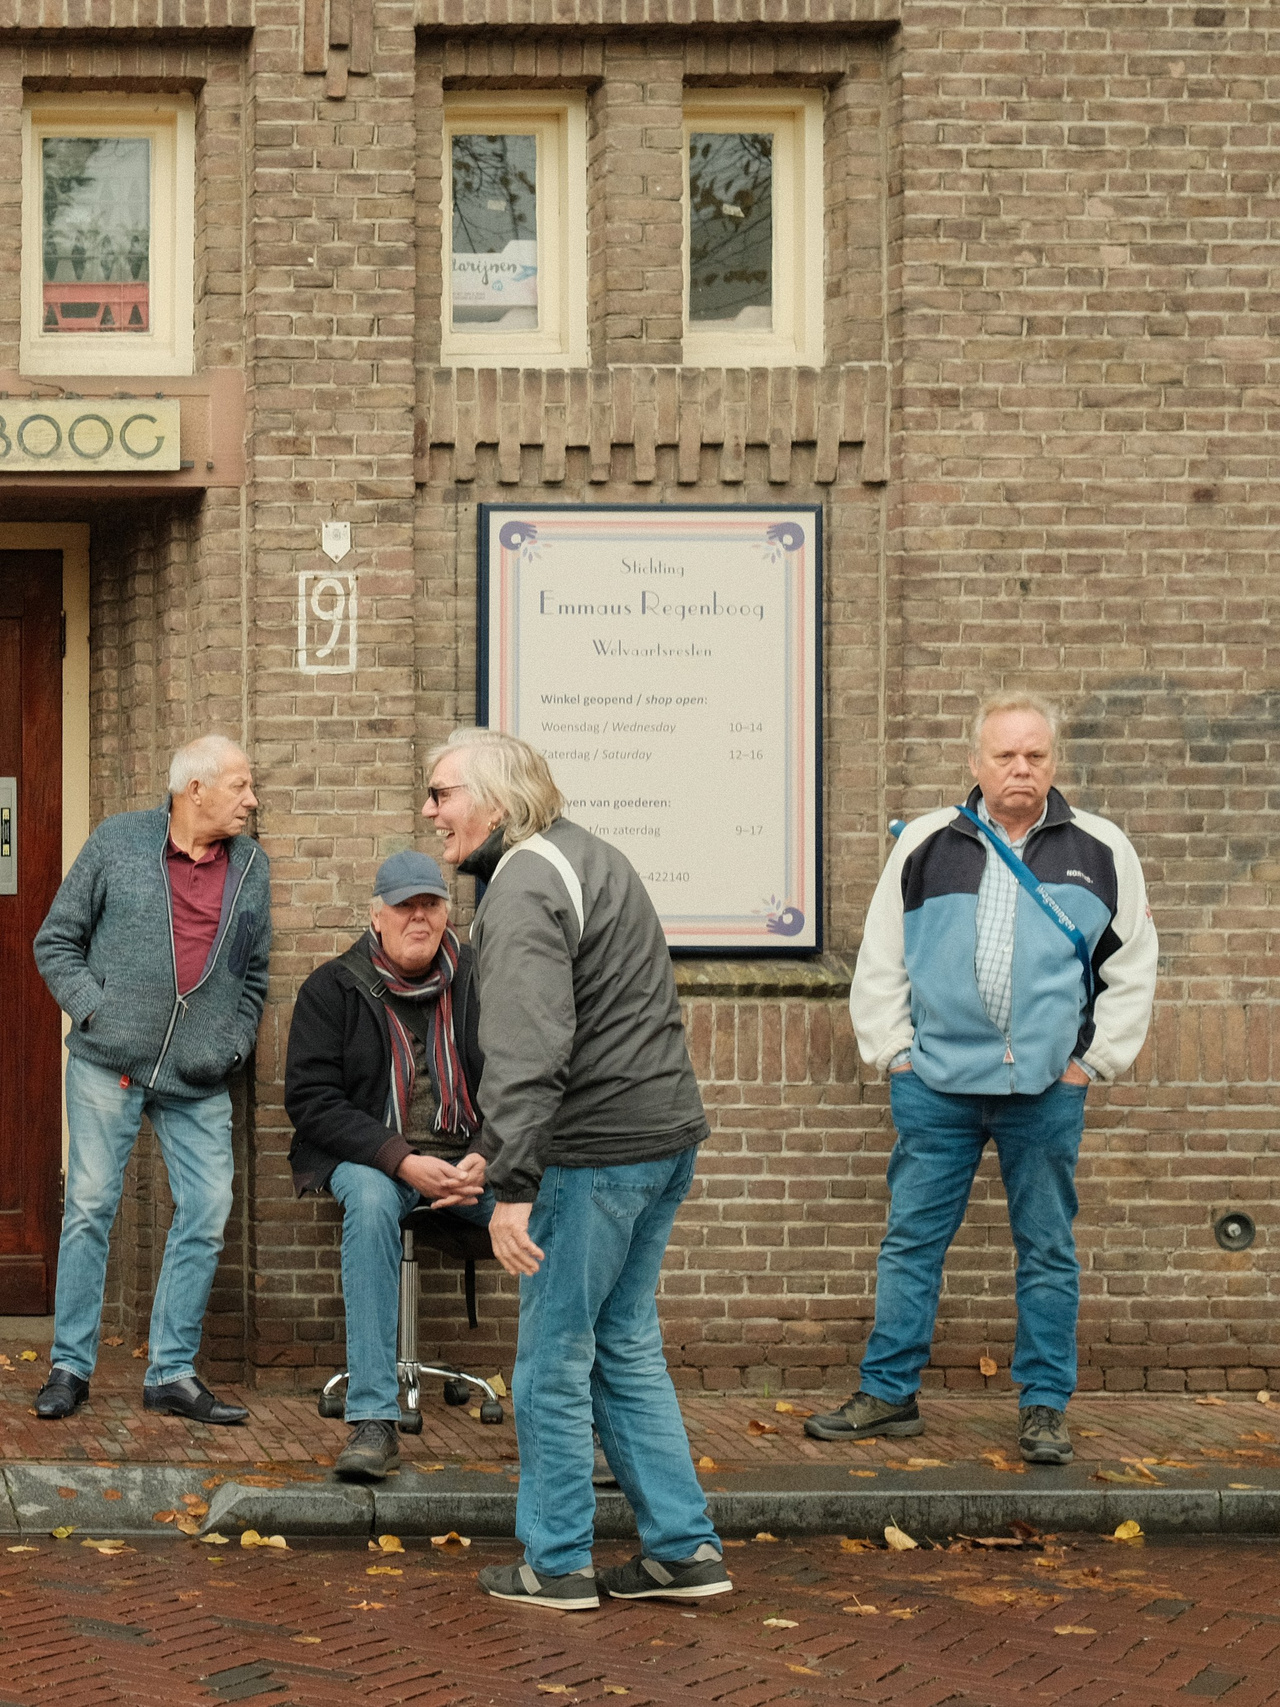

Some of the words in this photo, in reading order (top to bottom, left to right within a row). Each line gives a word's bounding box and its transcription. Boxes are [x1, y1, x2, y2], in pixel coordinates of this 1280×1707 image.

[620, 557, 685, 577] Stichting
[540, 589, 632, 615] Emmaus
[641, 589, 765, 621] Regenboog
[311, 578, 345, 658] 9
[592, 638, 712, 657] Welvaartsresten
[540, 694, 580, 705] Winkel
[583, 694, 633, 707] geopend
[645, 694, 672, 707] shop
[675, 696, 708, 707] open:
[541, 722, 600, 734] Woensdag
[612, 722, 676, 734] Wednesday
[541, 749, 590, 761] Zaterdag
[602, 750, 652, 761] Saturday
[590, 799, 610, 807] van
[613, 798, 671, 810] goederen:
[588, 824, 610, 836] t/m
[613, 825, 661, 837] zaterdag
